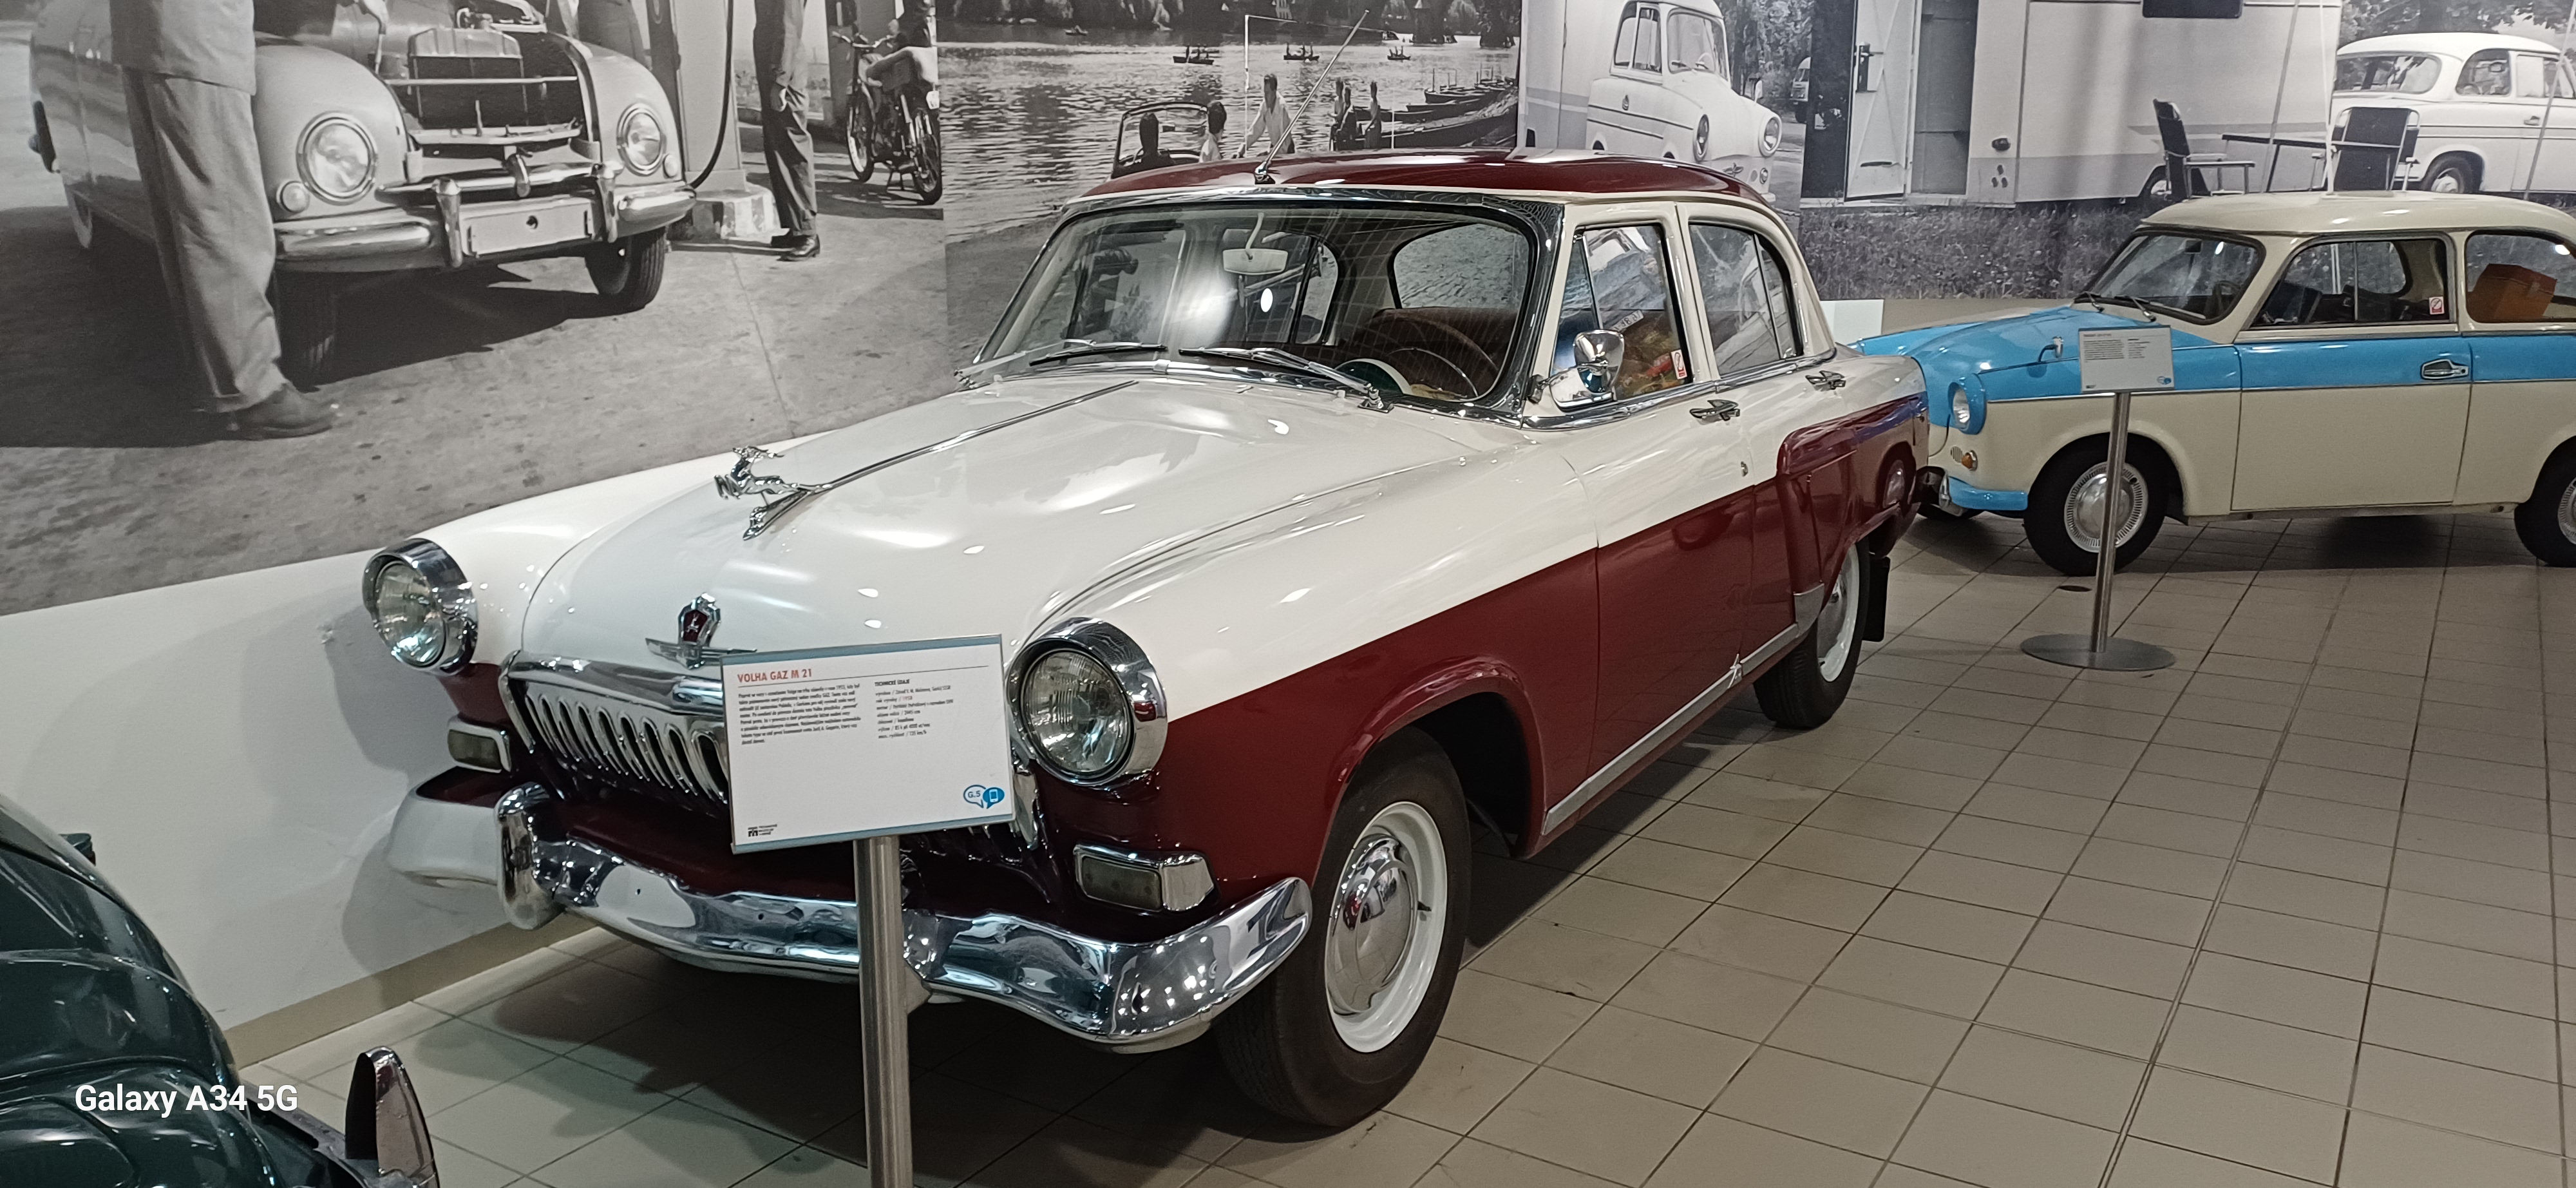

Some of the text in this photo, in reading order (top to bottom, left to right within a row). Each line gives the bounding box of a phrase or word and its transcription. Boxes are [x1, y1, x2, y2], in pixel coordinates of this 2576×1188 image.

[737, 669, 811, 683] VOLHA GAZ M 21
[967, 790, 981, 798] G.5
